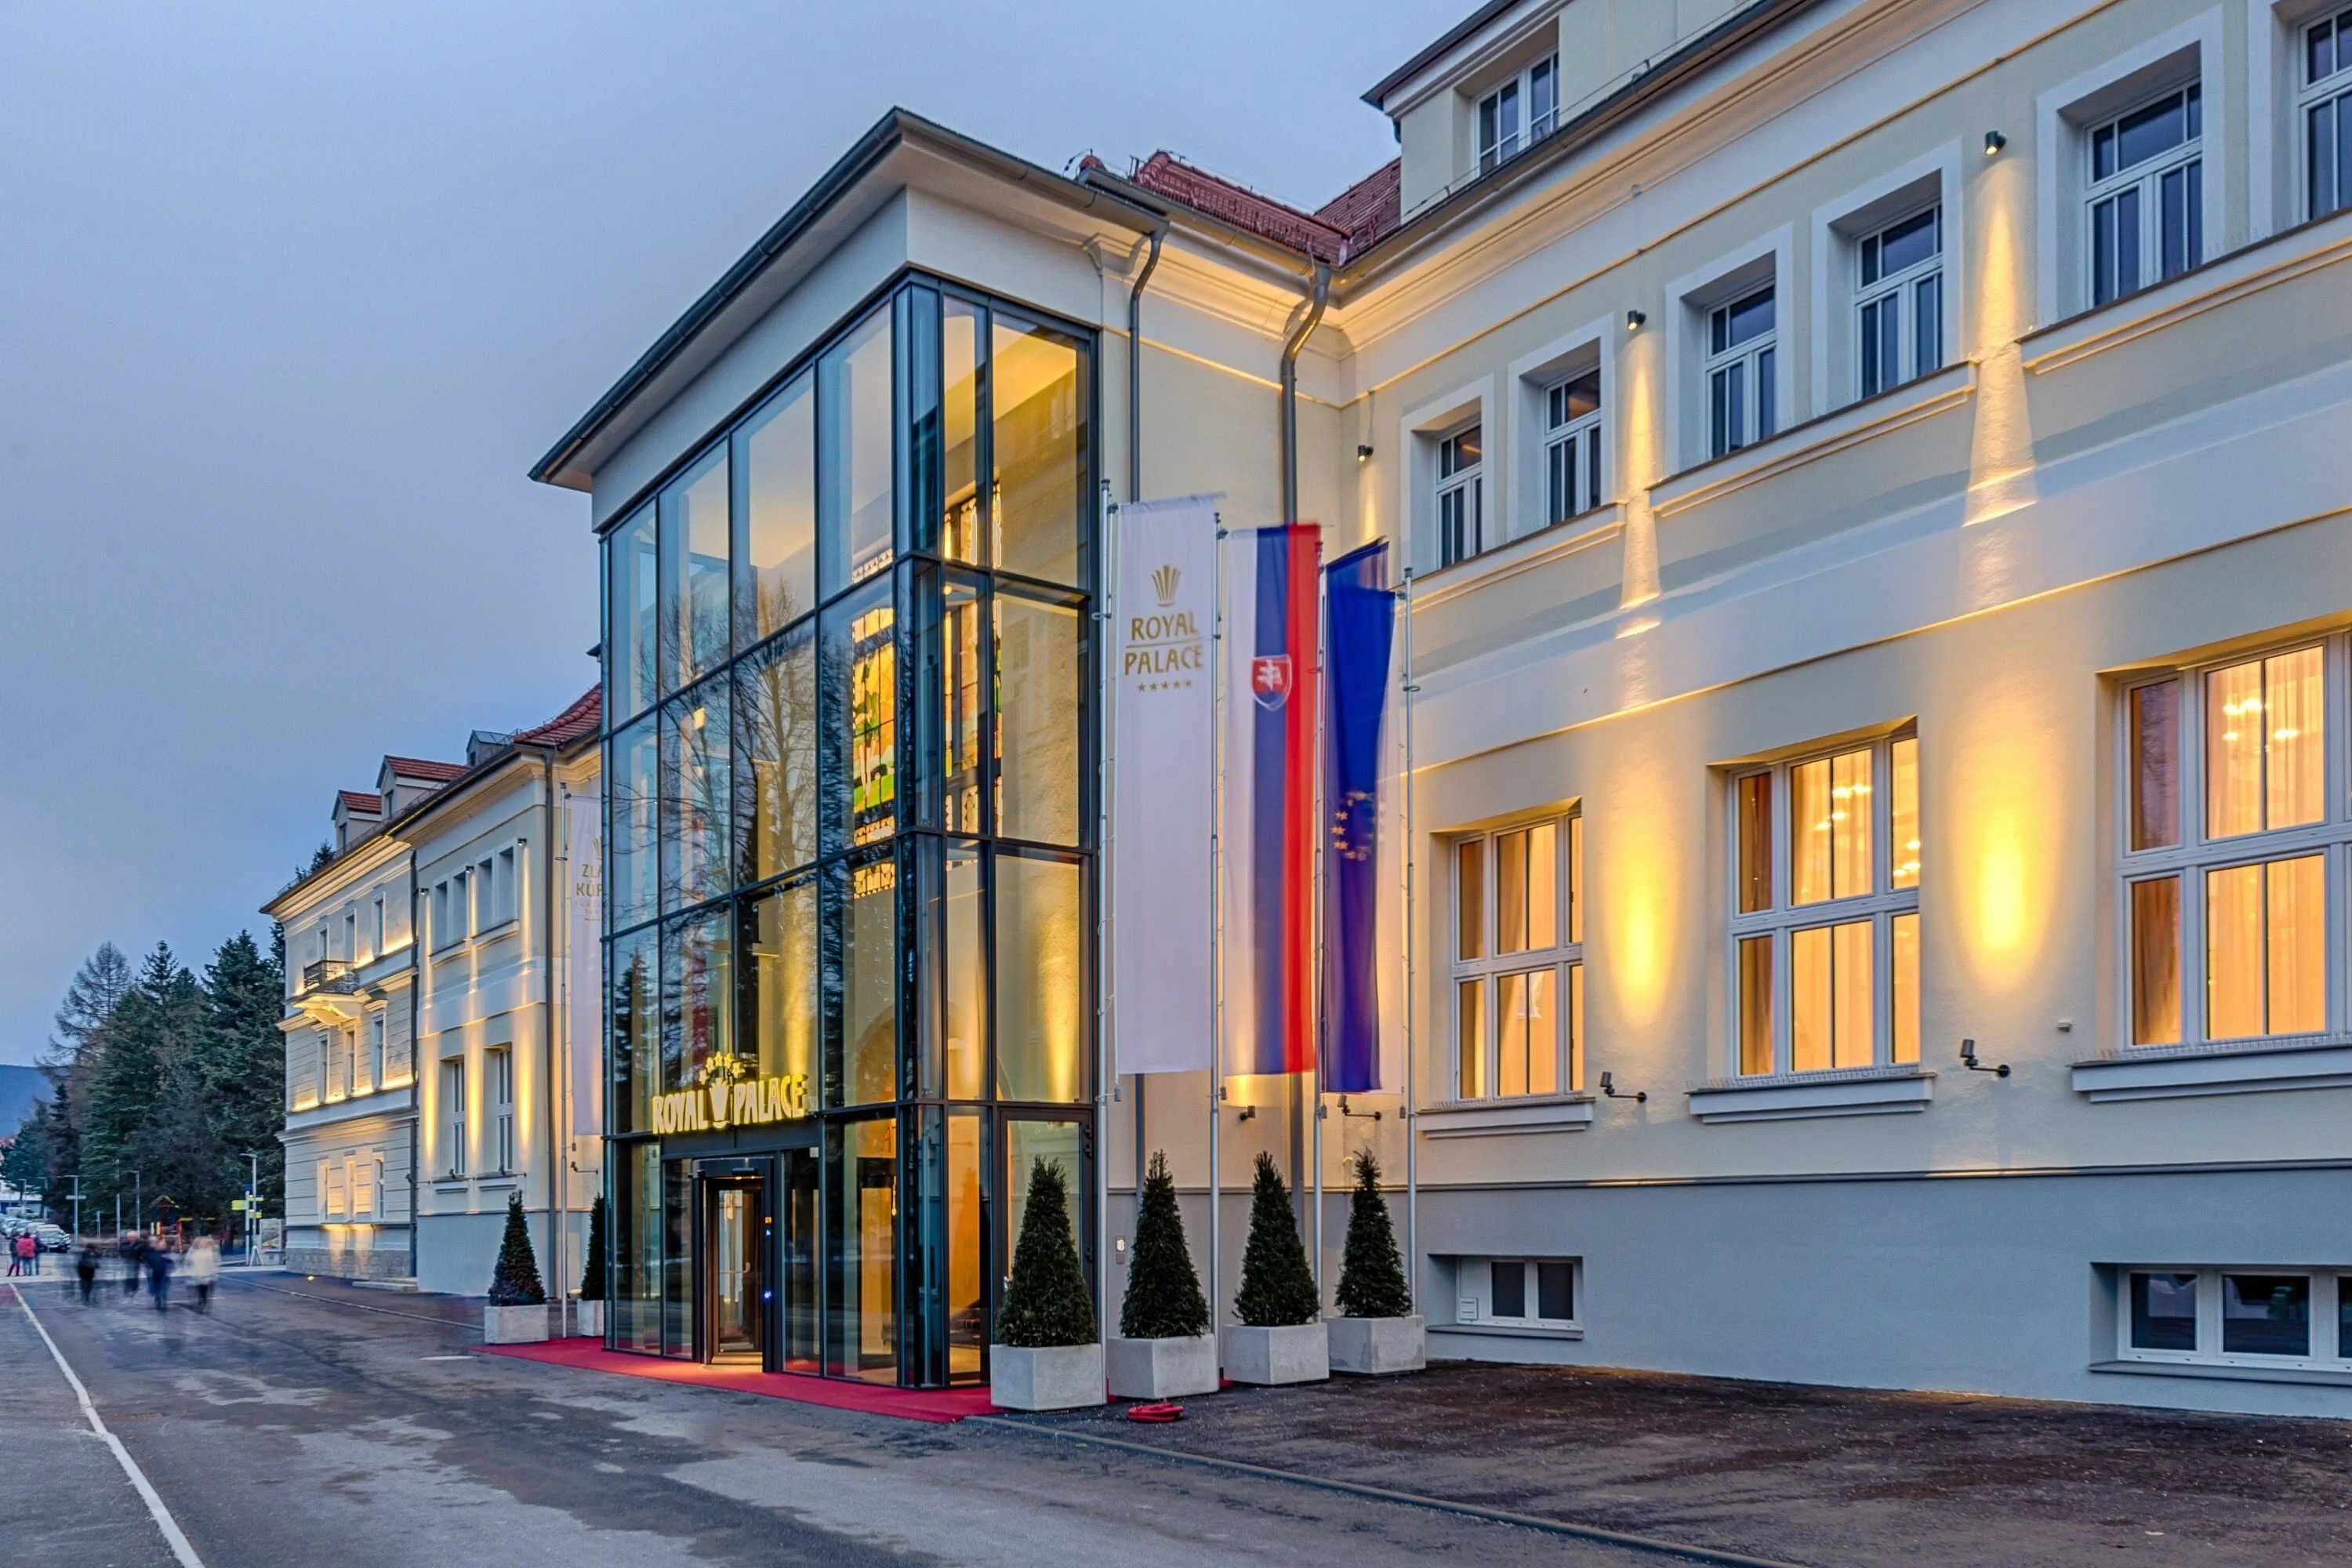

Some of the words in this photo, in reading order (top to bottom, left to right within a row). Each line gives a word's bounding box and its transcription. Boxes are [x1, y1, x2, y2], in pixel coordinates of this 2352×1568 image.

[1131, 611, 1199, 641] ROYAL
[1124, 644, 1203, 676] PALACE
[652, 1090, 709, 1134] ROYAL
[734, 1074, 808, 1125] PALACE
